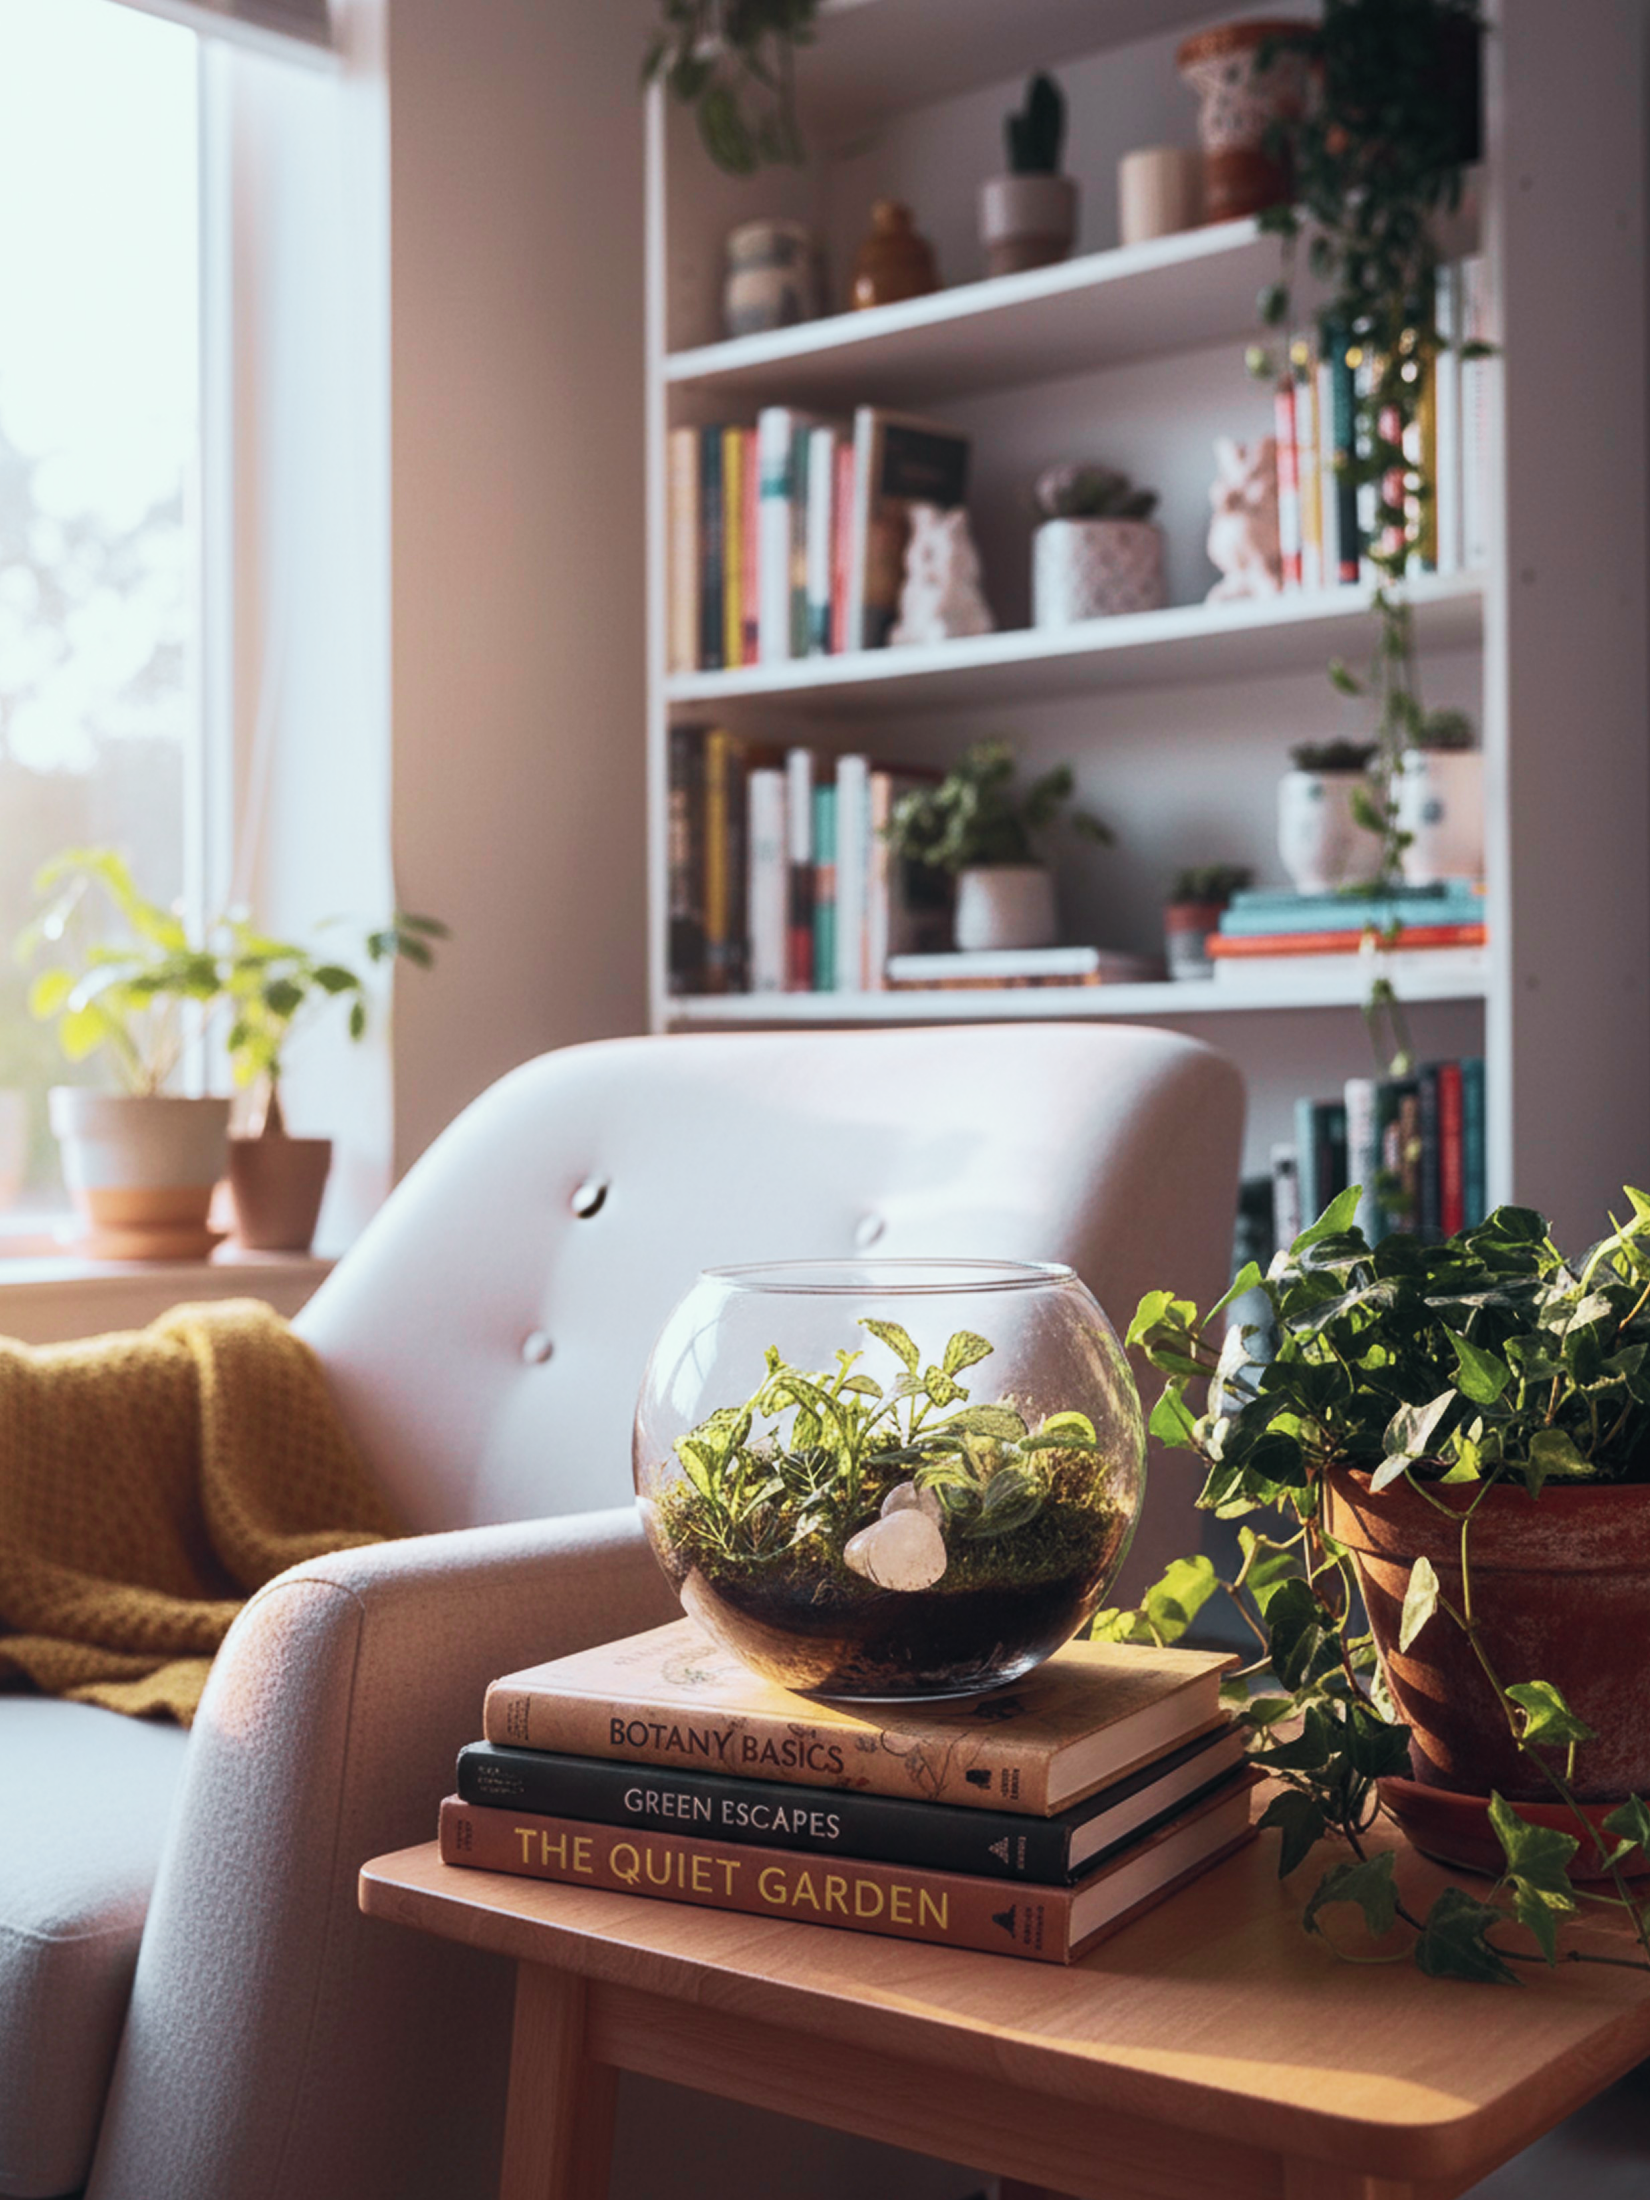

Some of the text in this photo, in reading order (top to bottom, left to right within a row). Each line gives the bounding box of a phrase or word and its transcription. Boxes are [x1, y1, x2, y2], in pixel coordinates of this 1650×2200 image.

[610, 1718, 844, 1774] BOTANY BASICS
[624, 1788, 840, 1838] GREEN ESCAPES
[514, 1827, 593, 1873] THE
[609, 1843, 741, 1895] QUIET
[758, 1867, 948, 1930] GARDEN
